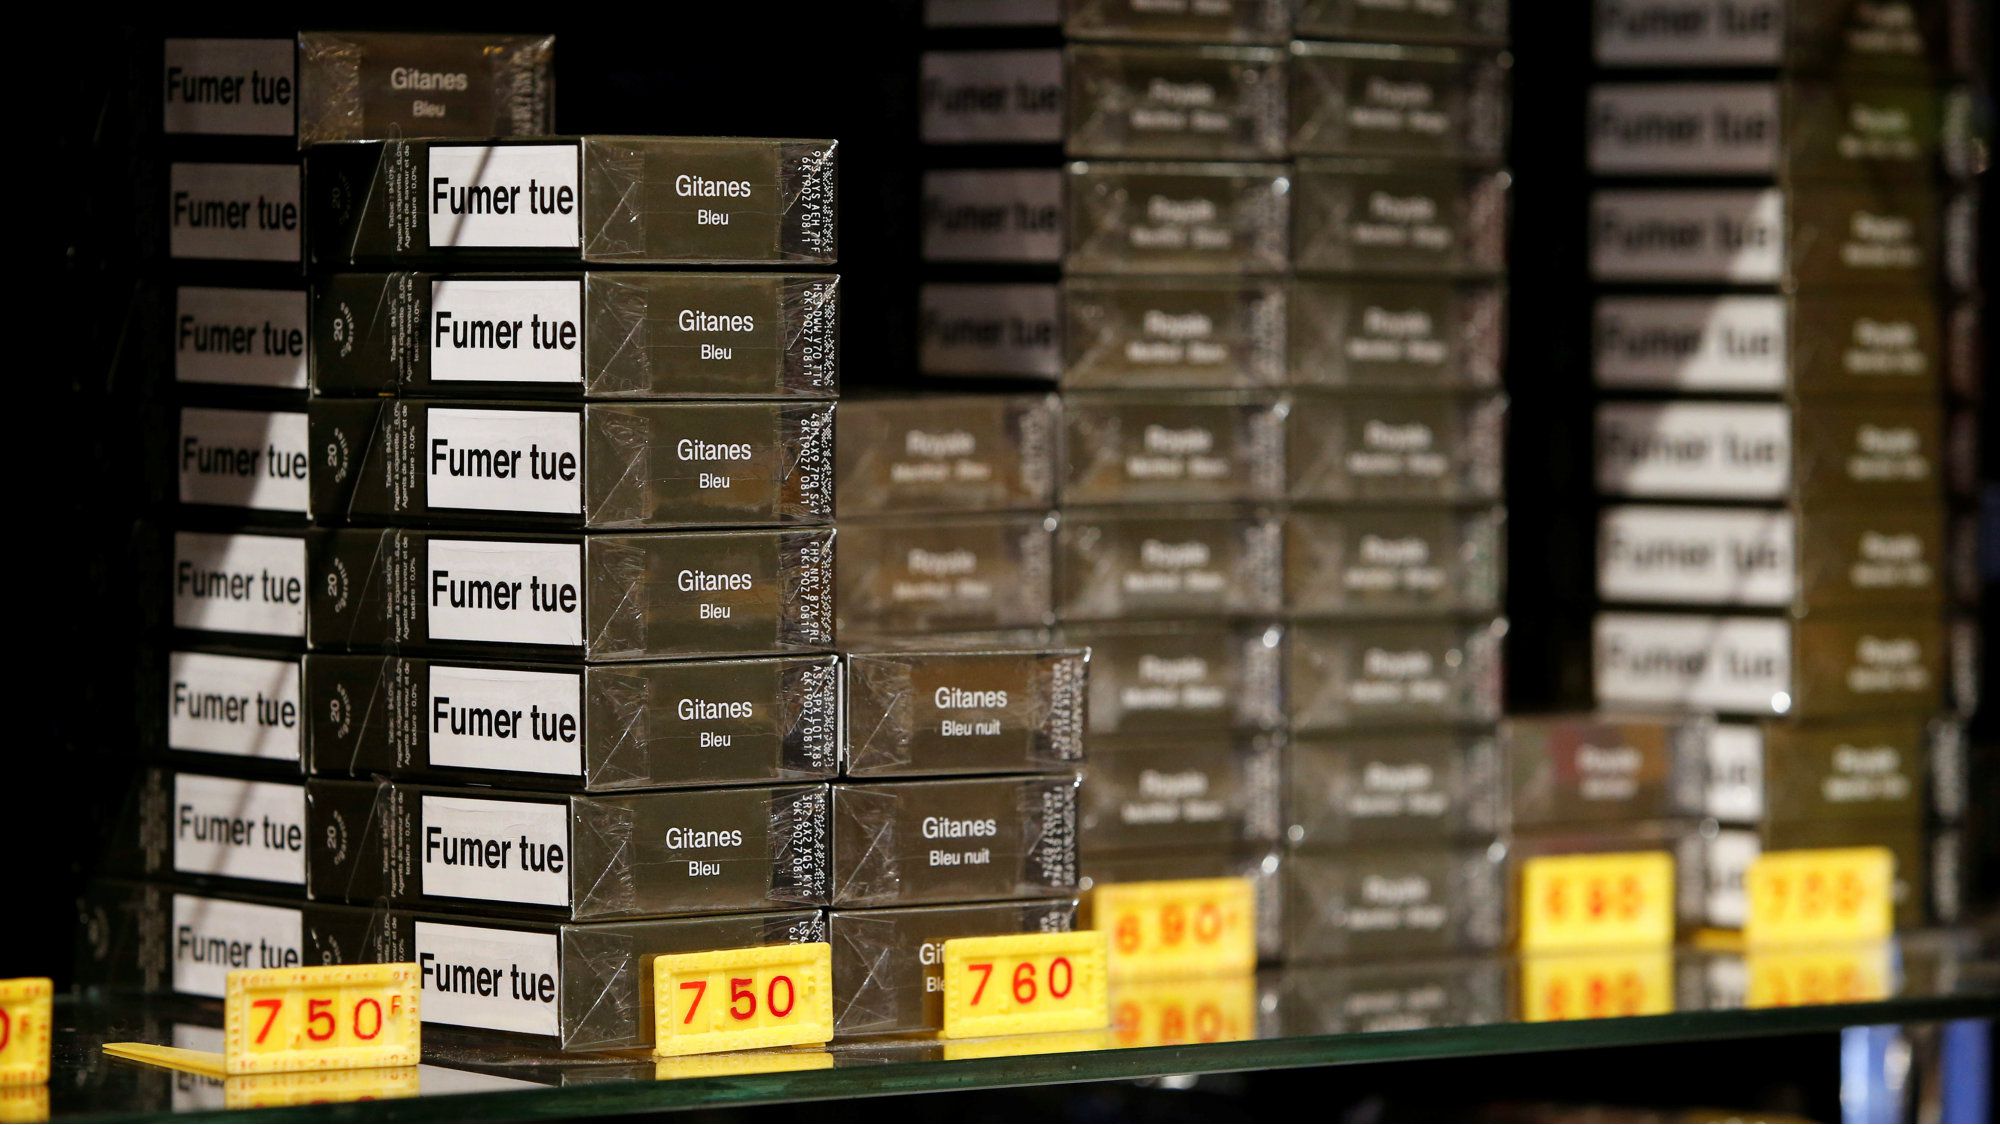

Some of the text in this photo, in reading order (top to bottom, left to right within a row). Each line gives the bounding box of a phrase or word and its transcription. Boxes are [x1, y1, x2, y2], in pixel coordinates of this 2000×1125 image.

[167, 67, 292, 106] Fumer tue
[391, 68, 467, 90] Gitanes
[413, 101, 445, 116] Bleu
[433, 178, 574, 215] Fumer tue
[676, 175, 750, 197] Gitanes
[810, 178, 821, 199] XYS
[174, 190, 297, 231] Fumer tue
[698, 210, 728, 225] Bleu
[810, 204, 821, 226] AEH
[801, 214, 811, 242] 0811
[333, 318, 343, 342] 20
[436, 312, 577, 350] Fumer tue
[679, 310, 753, 331] Gitanes
[179, 315, 255, 356] Fumer
[263, 320, 304, 357] tue
[702, 345, 731, 359] Bleu
[803, 347, 813, 376] 0811
[183, 439, 260, 477] Fumer
[268, 445, 307, 479] tue
[327, 443, 338, 467] 20
[431, 439, 577, 481] Fumer tue
[678, 439, 751, 460] Gitanes
[809, 440, 819, 462] 4X9
[700, 474, 729, 488] Bleu
[801, 476, 810, 504] 0811
[809, 493, 819, 515] S4Y
[178, 562, 253, 601] Fumer
[262, 569, 301, 604] tue
[327, 573, 338, 597] 20
[432, 571, 577, 613] Fumer tue
[678, 570, 751, 591] Gitanes
[809, 541, 819, 643] FH9 NRY 87X 9RL
[701, 604, 730, 618] Bleu
[800, 605, 810, 633] 0811
[174, 682, 248, 721] Fumer
[256, 689, 295, 727] tue
[812, 692, 822, 713] 3PX
[935, 687, 1007, 708] Gitanes
[330, 699, 340, 722] 20
[433, 697, 577, 743] Fumer tue
[678, 699, 752, 720] Gitanes
[942, 719, 1000, 736] Bleu nuit
[701, 732, 730, 747] Bleu
[803, 727, 813, 756] 0811
[812, 745, 822, 767] X8S
[179, 805, 254, 845] Fumer
[263, 812, 301, 851] tue
[327, 825, 337, 849] 20
[666, 828, 741, 849] Gitanes
[802, 821, 812, 843] 6X2
[923, 817, 996, 838] Gitanes
[427, 827, 564, 873] Fumer tue
[930, 849, 989, 865] Bleu nuit
[689, 861, 719, 876] Bleu
[793, 858, 802, 886] 0811
[802, 874, 812, 897] KY6
[177, 927, 298, 967] Fumer tue
[420, 953, 555, 1003] Fumer tue
